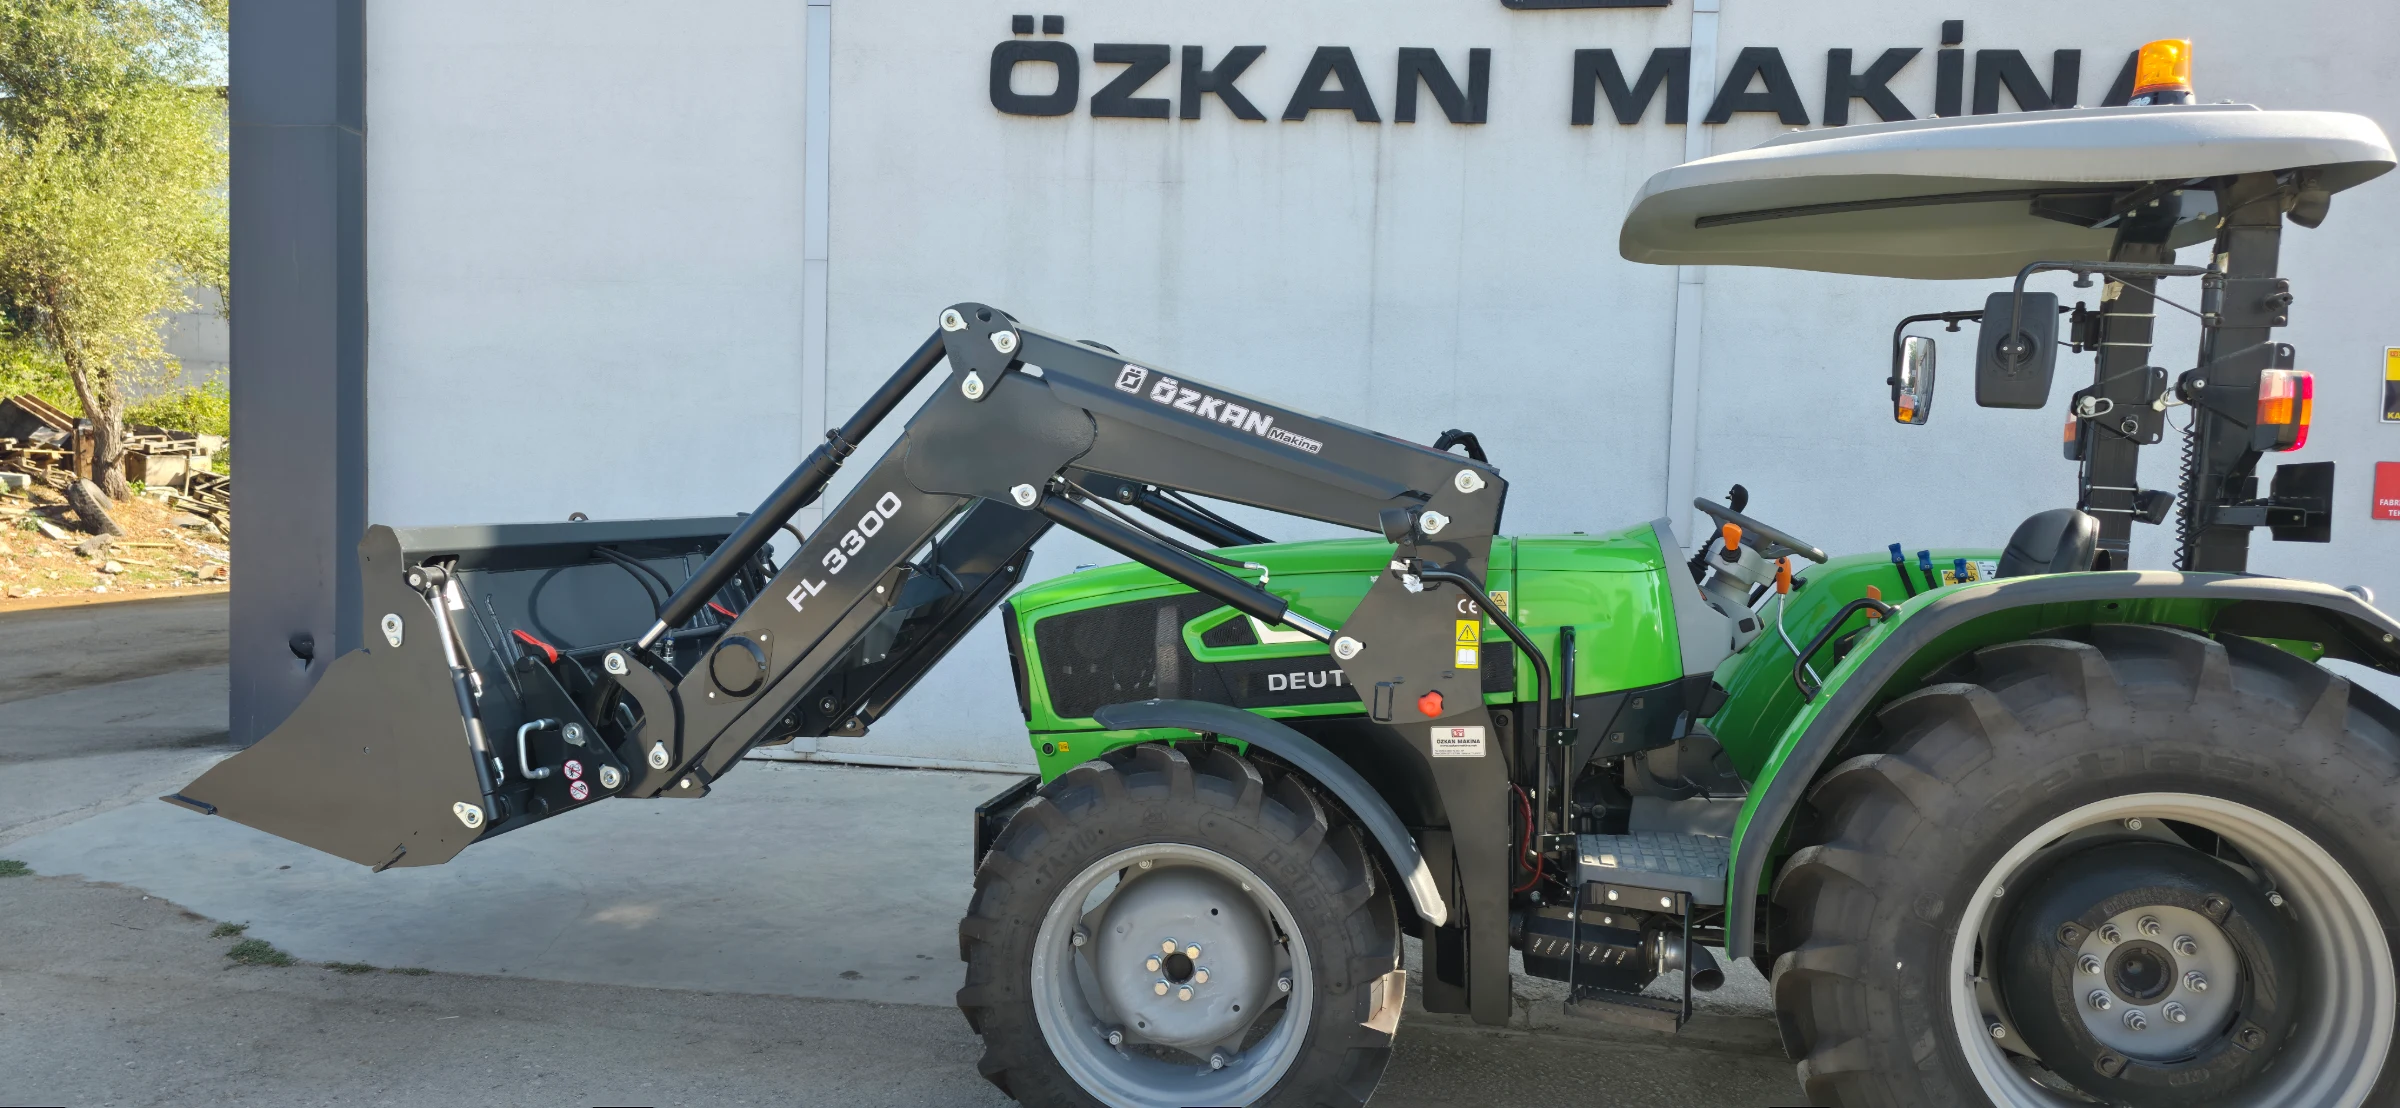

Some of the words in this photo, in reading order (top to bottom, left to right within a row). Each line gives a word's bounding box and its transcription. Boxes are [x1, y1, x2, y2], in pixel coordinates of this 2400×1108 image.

[989, 15, 1491, 124] ÖZKAN
[1150, 376, 1274, 436] ÖZKAN
[1269, 428, 1319, 453] Makina
[2379, 498, 2400, 506] FABR
[786, 578, 827, 612] FL
[821, 491, 902, 575] 3300
[1267, 668, 1353, 692] DEUT
[1037, 828, 1098, 880] TA-110
